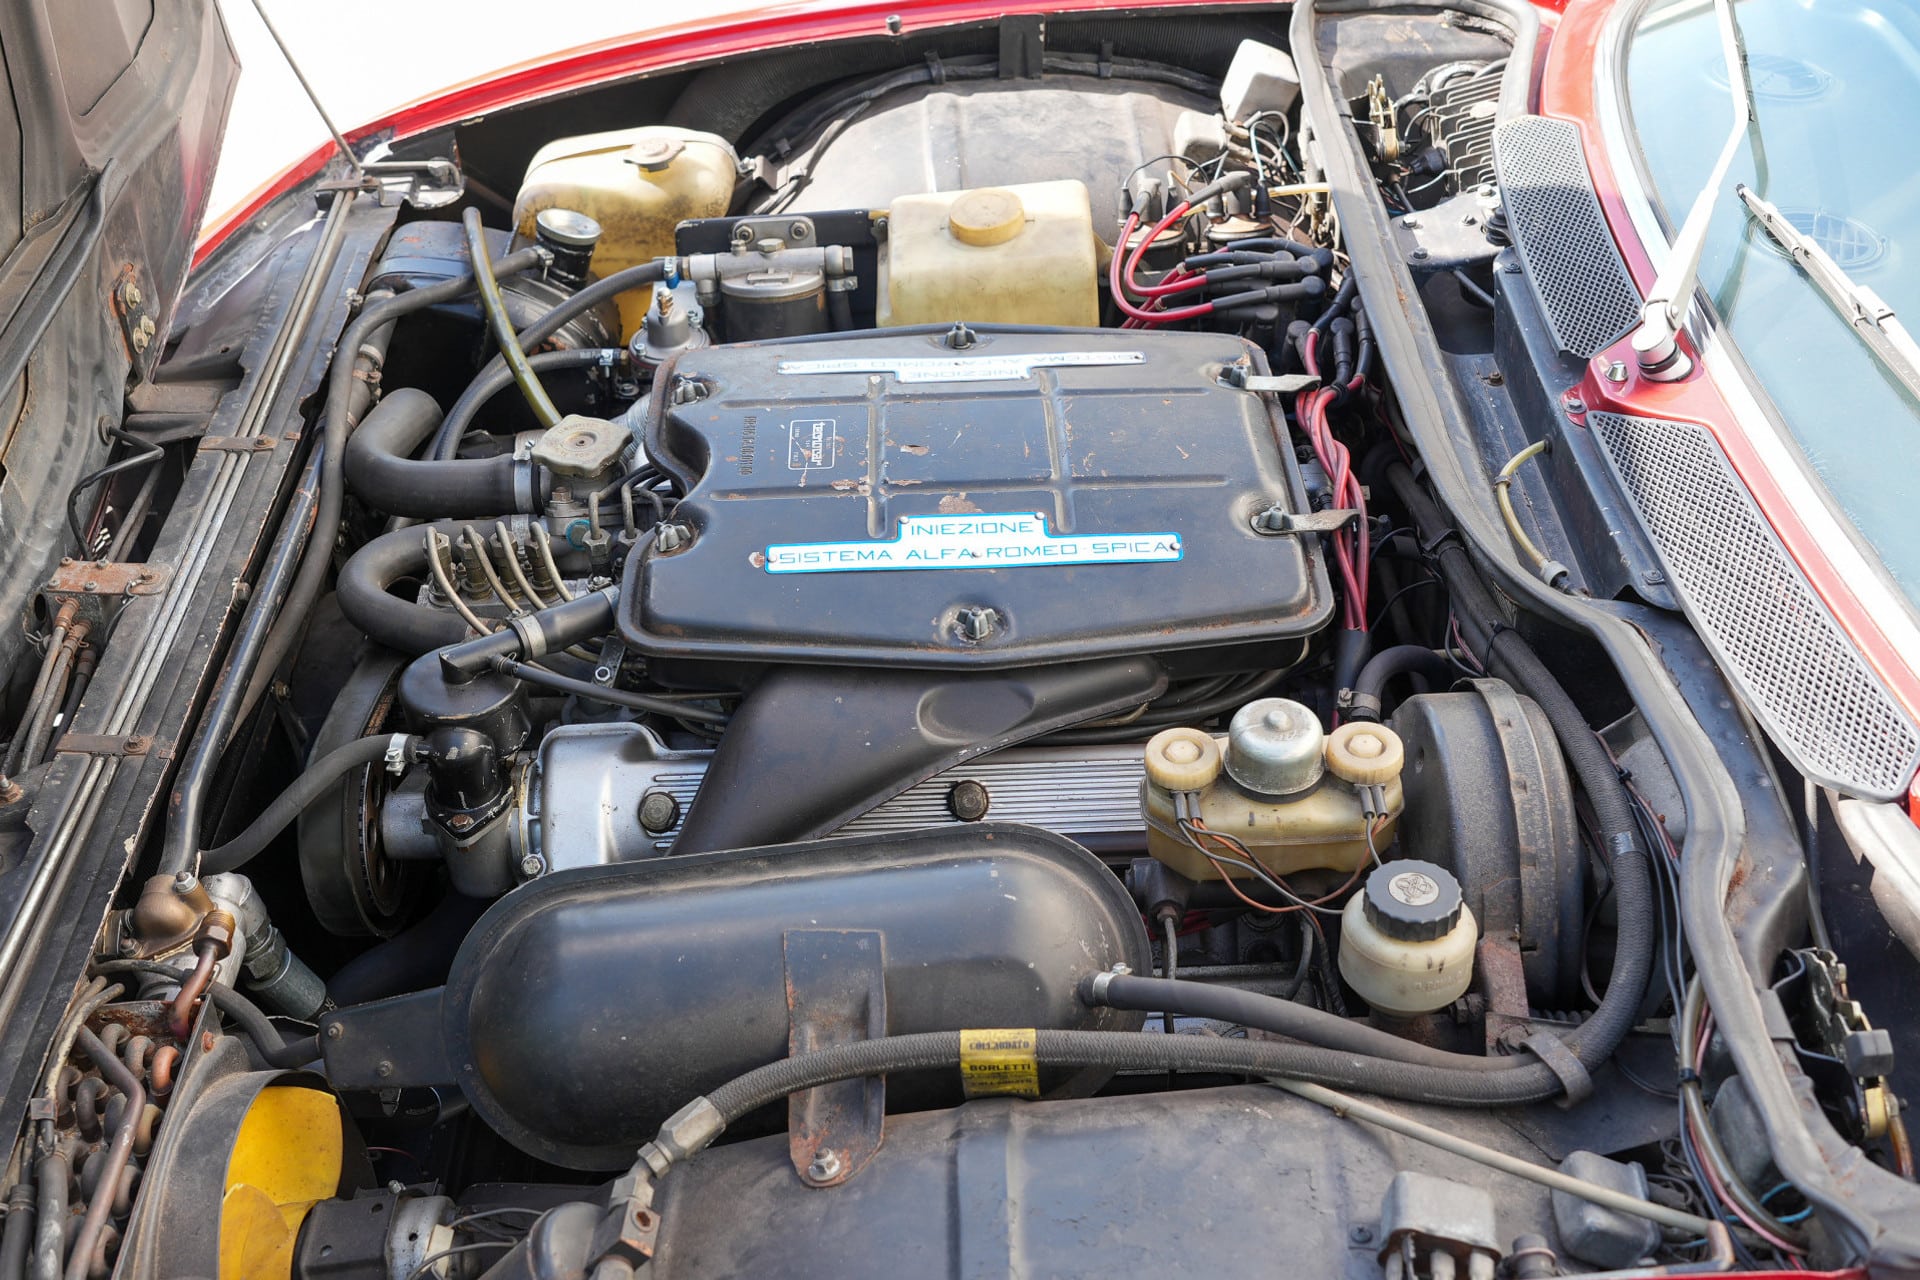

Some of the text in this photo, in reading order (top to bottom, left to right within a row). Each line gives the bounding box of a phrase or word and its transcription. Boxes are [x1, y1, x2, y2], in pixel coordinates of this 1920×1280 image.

[908, 370, 1018, 379] INIEZIONE
[911, 522, 1034, 535] INIEZIONE
[779, 542, 1169, 564] SISTEMA ALFA ROMEO SPICA
[969, 1063, 1031, 1071] BORLETTI
